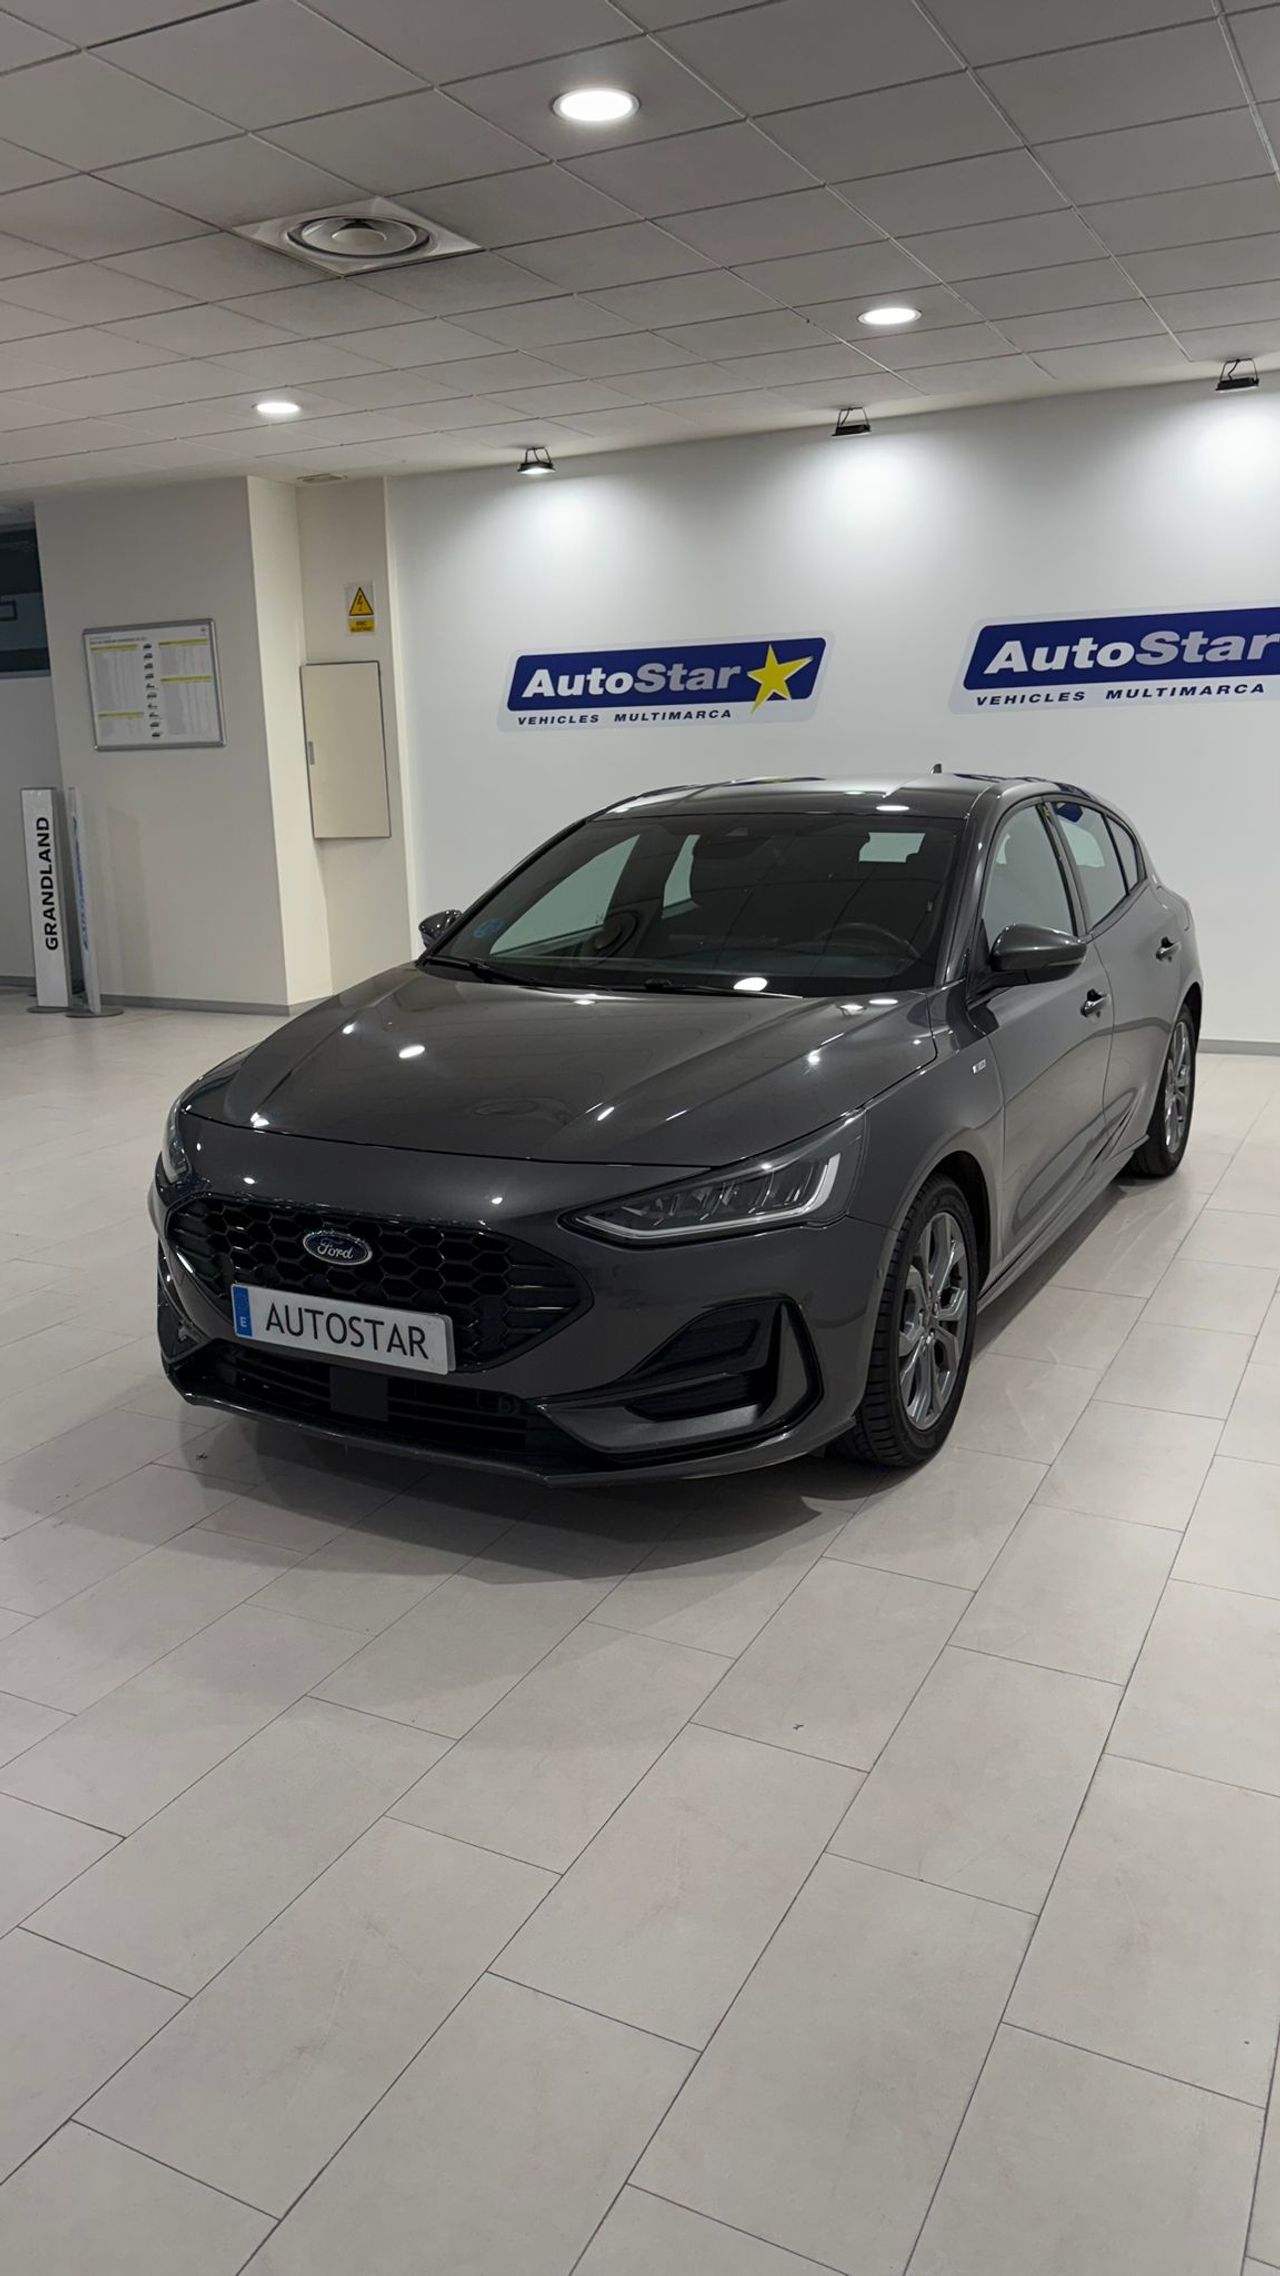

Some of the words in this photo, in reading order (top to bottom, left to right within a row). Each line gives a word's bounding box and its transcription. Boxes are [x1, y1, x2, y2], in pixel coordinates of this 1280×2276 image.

[983, 631, 1280, 674] AutoStar
[521, 662, 741, 698] AutoStar
[976, 691, 1086, 706] VEHICLES
[1105, 683, 1265, 700] MULTIMARCA
[518, 714, 599, 725] VEHICLES
[614, 709, 732, 722] MULTIMARCA
[36, 817, 58, 950] GRANDLAND
[316, 1238, 354, 1260] Ford
[240, 1316, 247, 1328] E
[265, 1303, 429, 1360] AUTOSTAR
